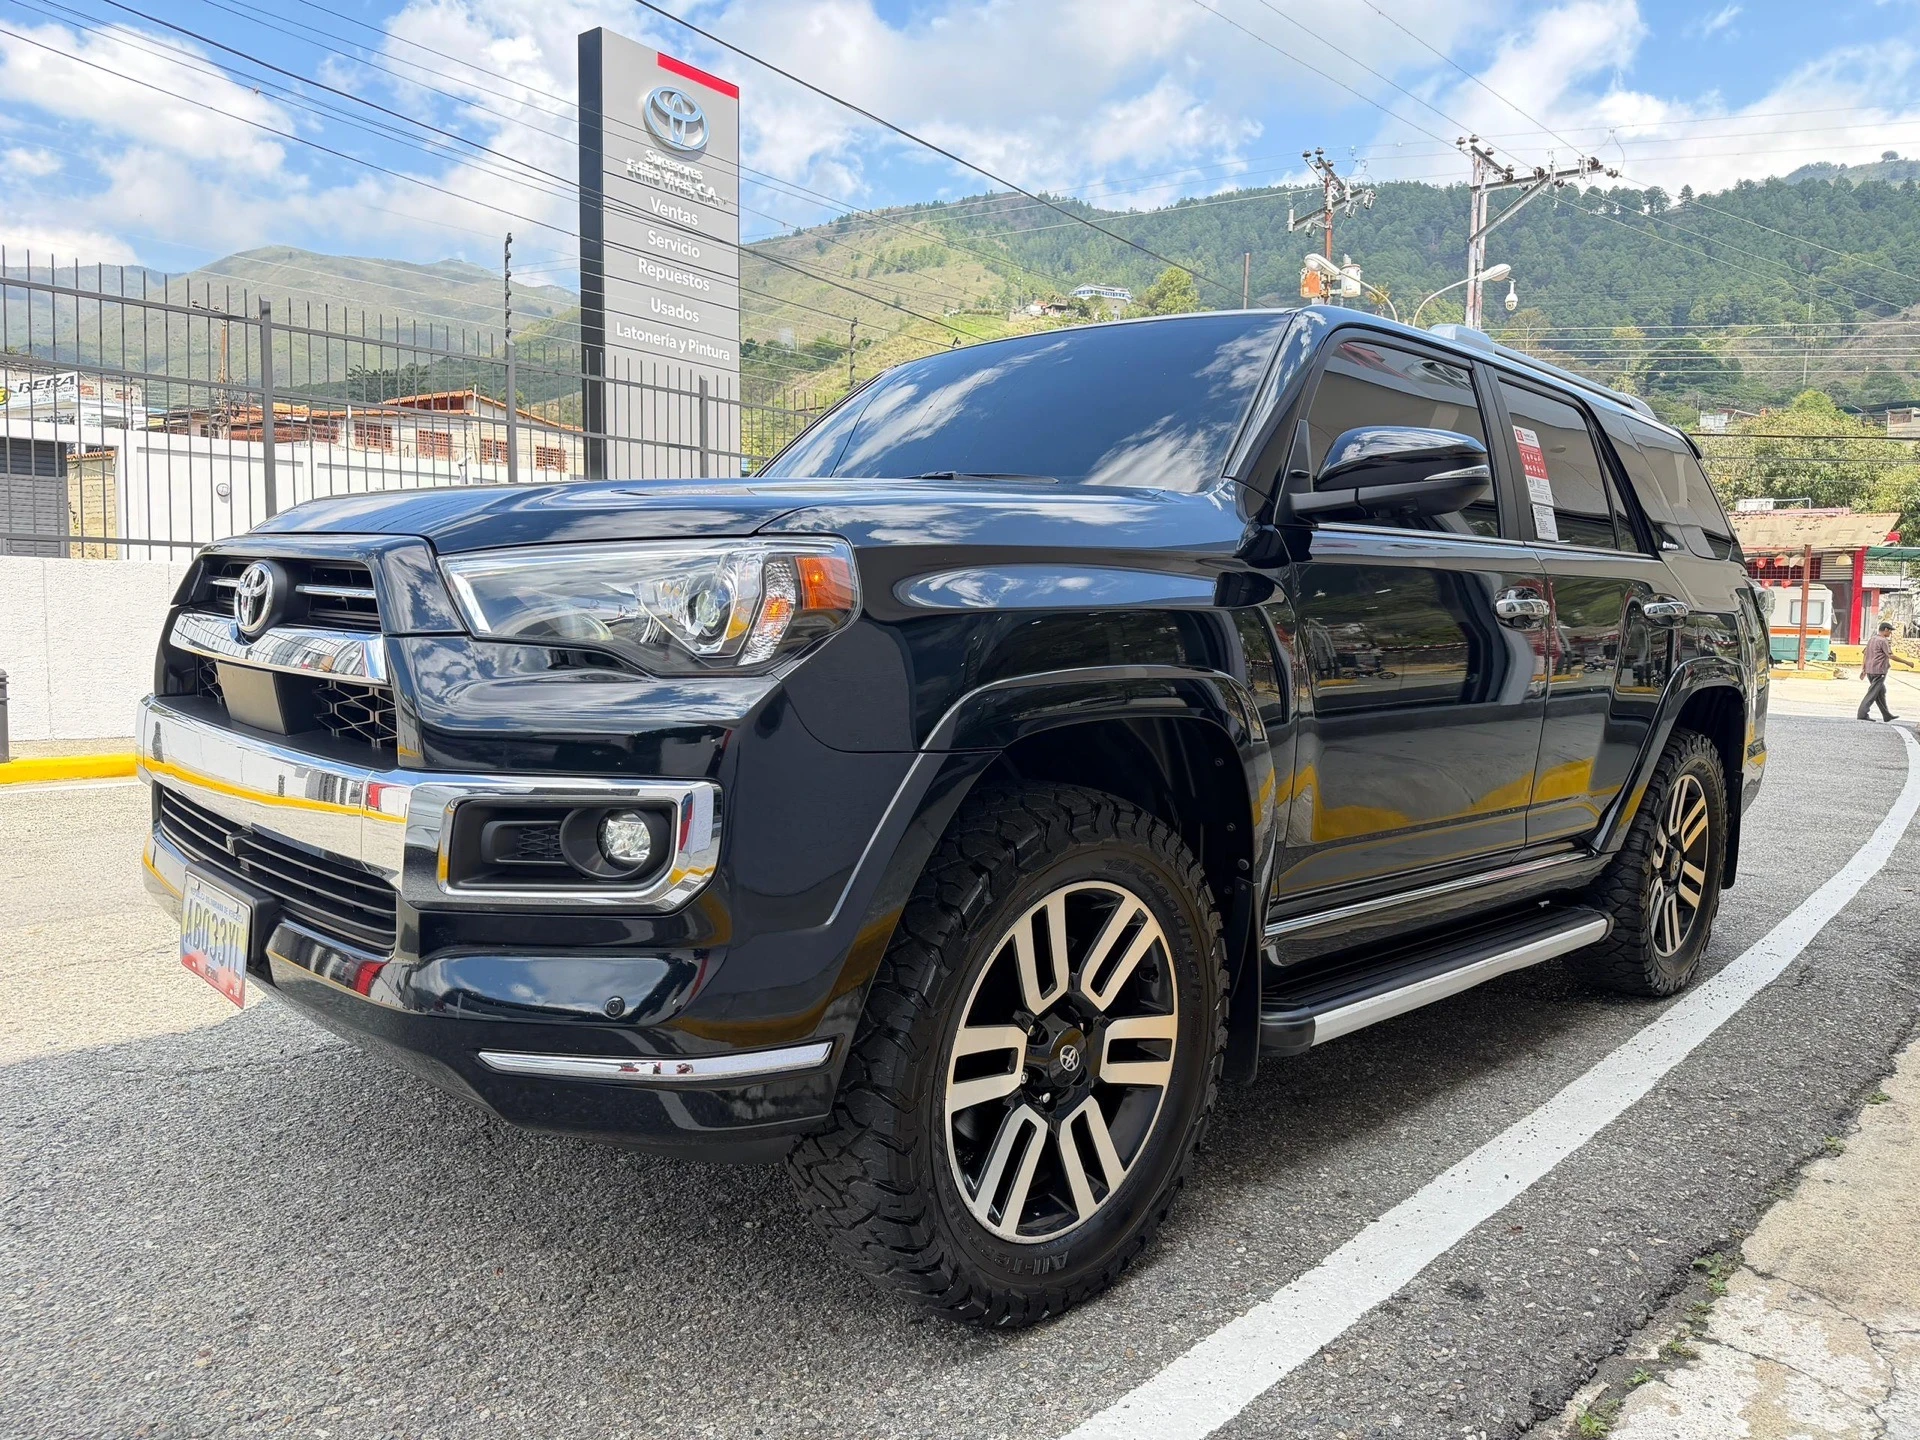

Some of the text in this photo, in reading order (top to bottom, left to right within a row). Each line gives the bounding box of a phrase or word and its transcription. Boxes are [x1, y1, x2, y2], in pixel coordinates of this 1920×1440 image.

[644, 149, 703, 181] Sucesores
[650, 196, 699, 226] Ventas
[648, 230, 701, 259] Servicio
[638, 257, 710, 292] Repuestos
[650, 297, 700, 323] Usados
[615, 321, 731, 361] Latonería y Pintura
